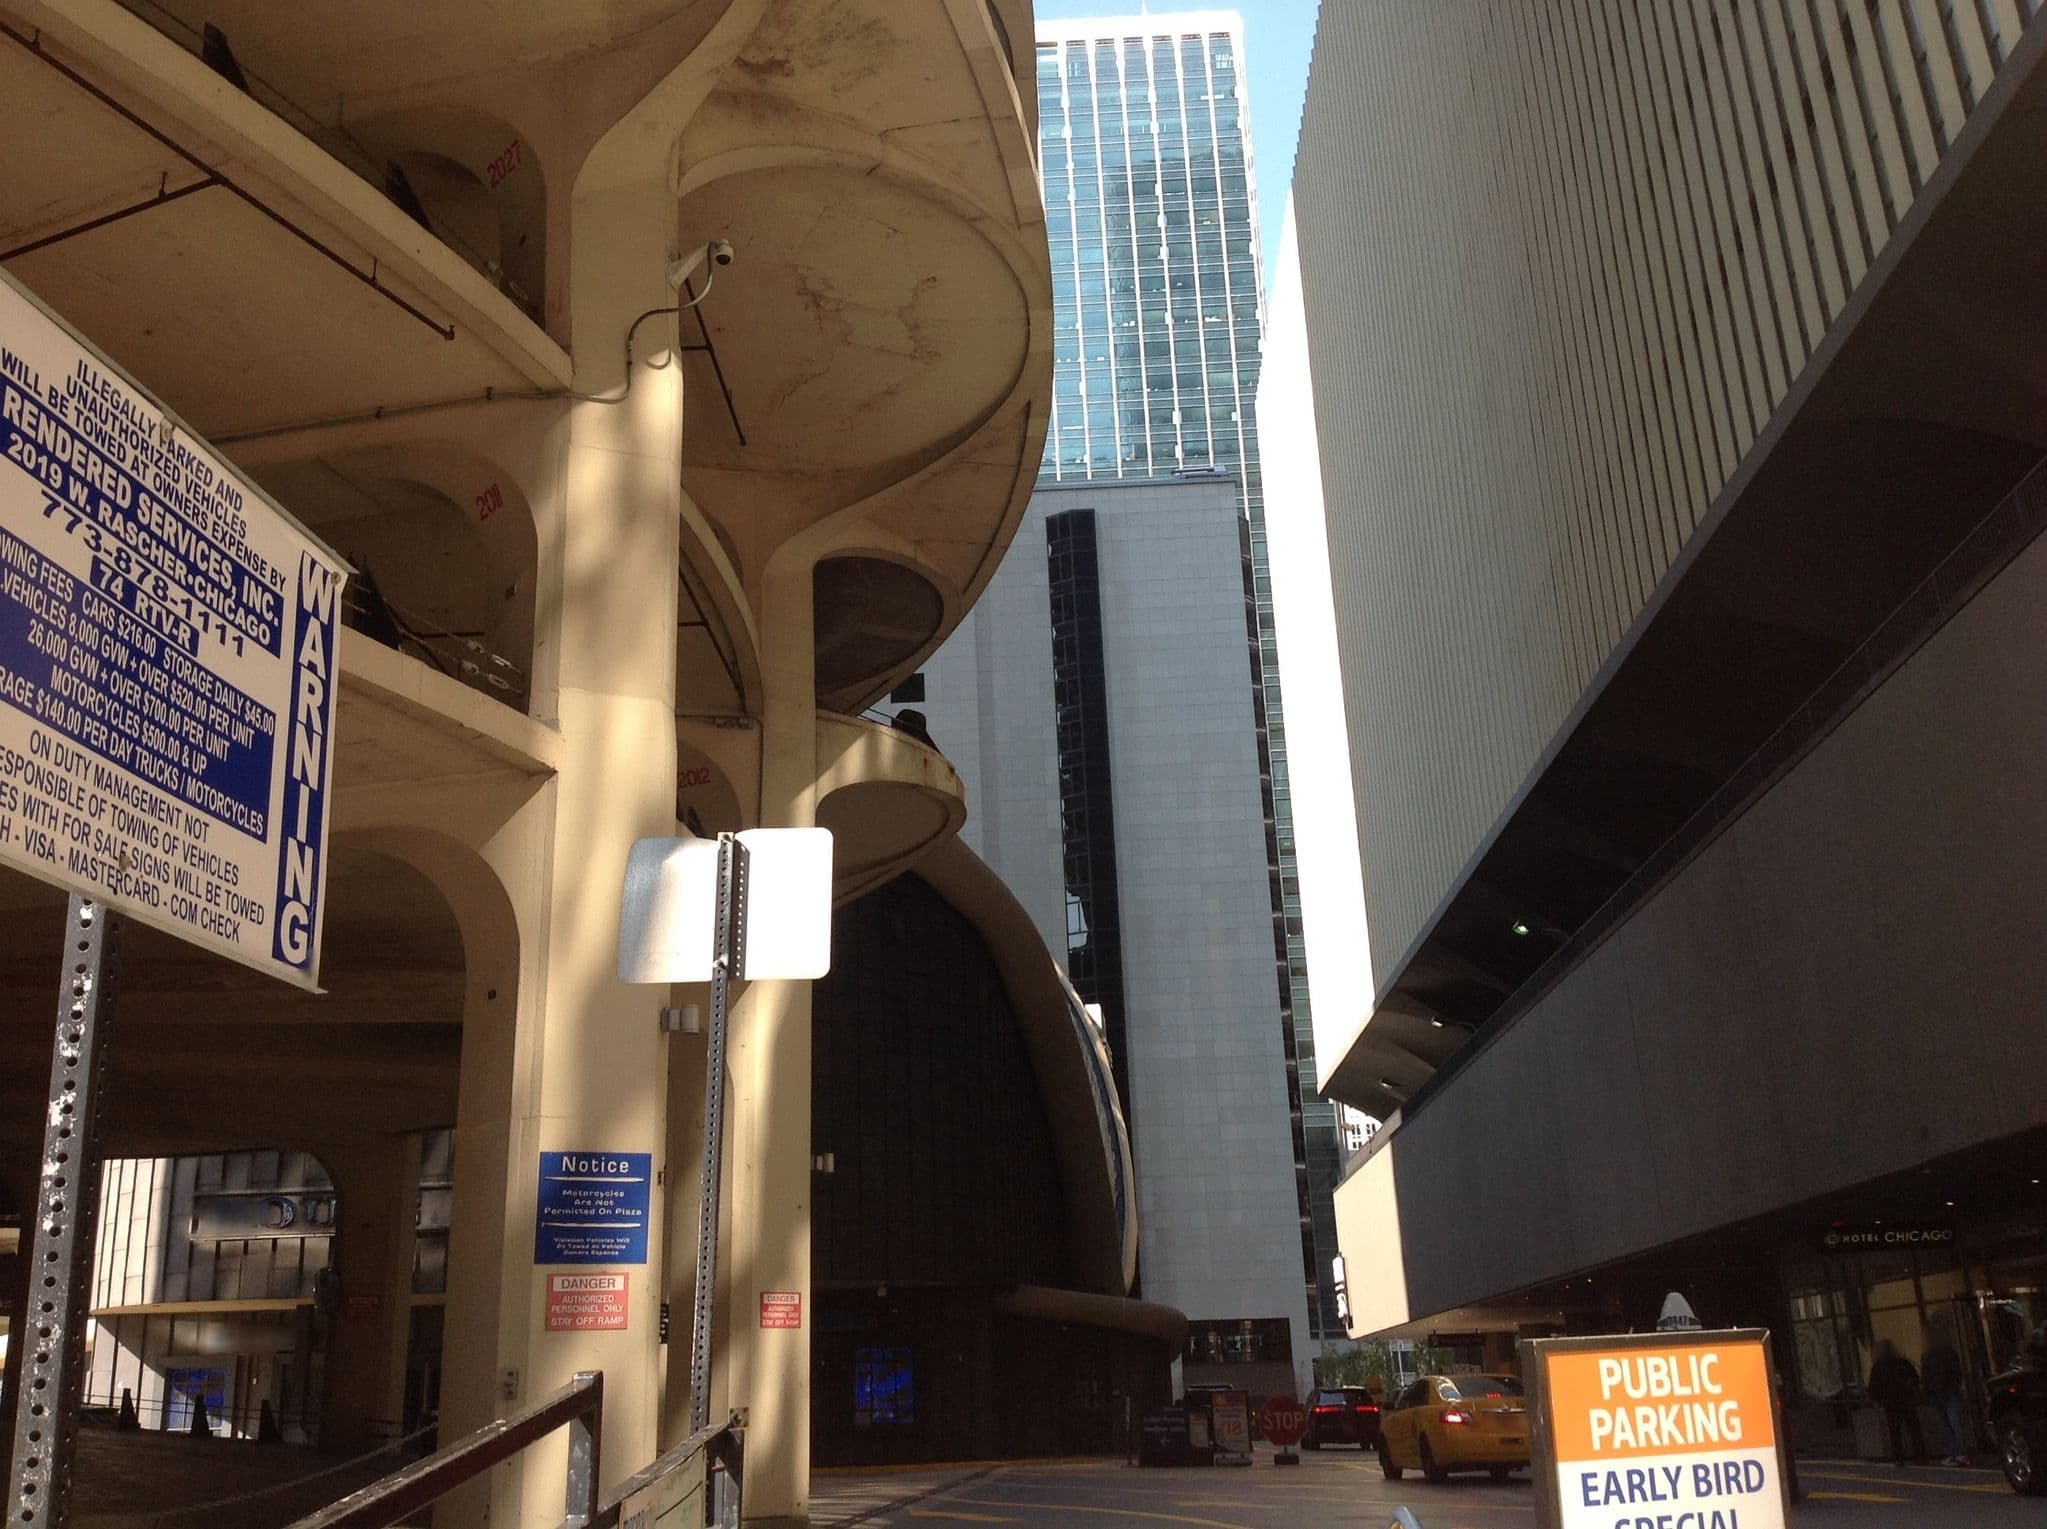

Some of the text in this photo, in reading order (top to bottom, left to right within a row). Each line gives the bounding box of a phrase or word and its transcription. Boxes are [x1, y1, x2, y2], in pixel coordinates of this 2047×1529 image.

[2, 347, 286, 592] WILL BE TOWED AT OWNERS EXPENSE BY
[8, 432, 62, 489] 2019
[69, 475, 91, 513] W.
[66, 374, 247, 540] UNAUTHORIZED VEHICLES
[77, 359, 243, 512] ILLEGALLY ARKED AND
[2, 384, 279, 627] RENDERED SERVICES, INC.
[41, 488, 244, 657] 773-878-1111
[99, 562, 191, 651] 74 RTV-R
[0, 533, 274, 736] WING FEES CARS $216.00 STORAGE DAILY $45.00
[68, 612, 99, 651] 8,000
[101, 634, 129, 670] GVW
[130, 656, 137, 672] +
[139, 659, 168, 697] OVER
[170, 679, 207, 721] $520.00
[208, 703, 230, 736] PER
[231, 718, 255, 750] UNIT
[27, 618, 230, 763] 26,000 GVW + OVER $700.00 PER UNIT
[50, 664, 207, 776] MOTORCYCLES $500.00 & UP
[30, 729, 210, 844] ON DUTY MANAGEMENT NOT
[36, 687, 81, 735] $140.00
[83, 715, 108, 752] PER
[109, 731, 134, 764] DAY
[135, 746, 179, 791] TRUCKS
[186, 775, 264, 835] MOTORCYCLES
[279, 553, 333, 965] WARNING
[23, 791, 59, 832] WITH
[62, 811, 91, 848] FOR
[130, 846, 170, 884] SIGNS
[174, 865, 202, 899] WILL
[205, 880, 221, 908] BE
[225, 889, 265, 926] TOWED
[25, 825, 56, 864] VISA
[68, 846, 160, 908] MASTERCARD
[170, 894, 198, 925] COM
[200, 907, 241, 944] CHECK
[88, 793, 107, 820] OF
[111, 803, 159, 849] TOWING
[162, 831, 179, 857] OF
[182, 840, 239, 887] VEHICLES
[544, 1207, 642, 1216] Permitted On Plaza
[562, 1156, 629, 1173] Notice
[562, 1189, 625, 1198] Motorcycles
[561, 1278, 616, 1289] DANGER
[1843, 1230, 1952, 1243] HOTEL CHICAGO
[551, 1304, 624, 1313] PERSONNEL ONLY
[551, 1316, 624, 1326] STAY OFF RAMP
[562, 1295, 614, 1303] AUTHORIZED
[1263, 1411, 1304, 1431] STOP
[1599, 1353, 1722, 1400] PUBLIC
[1589, 1400, 1743, 1450] PARKING
[1580, 1459, 1765, 1507] EARLY BIRD
